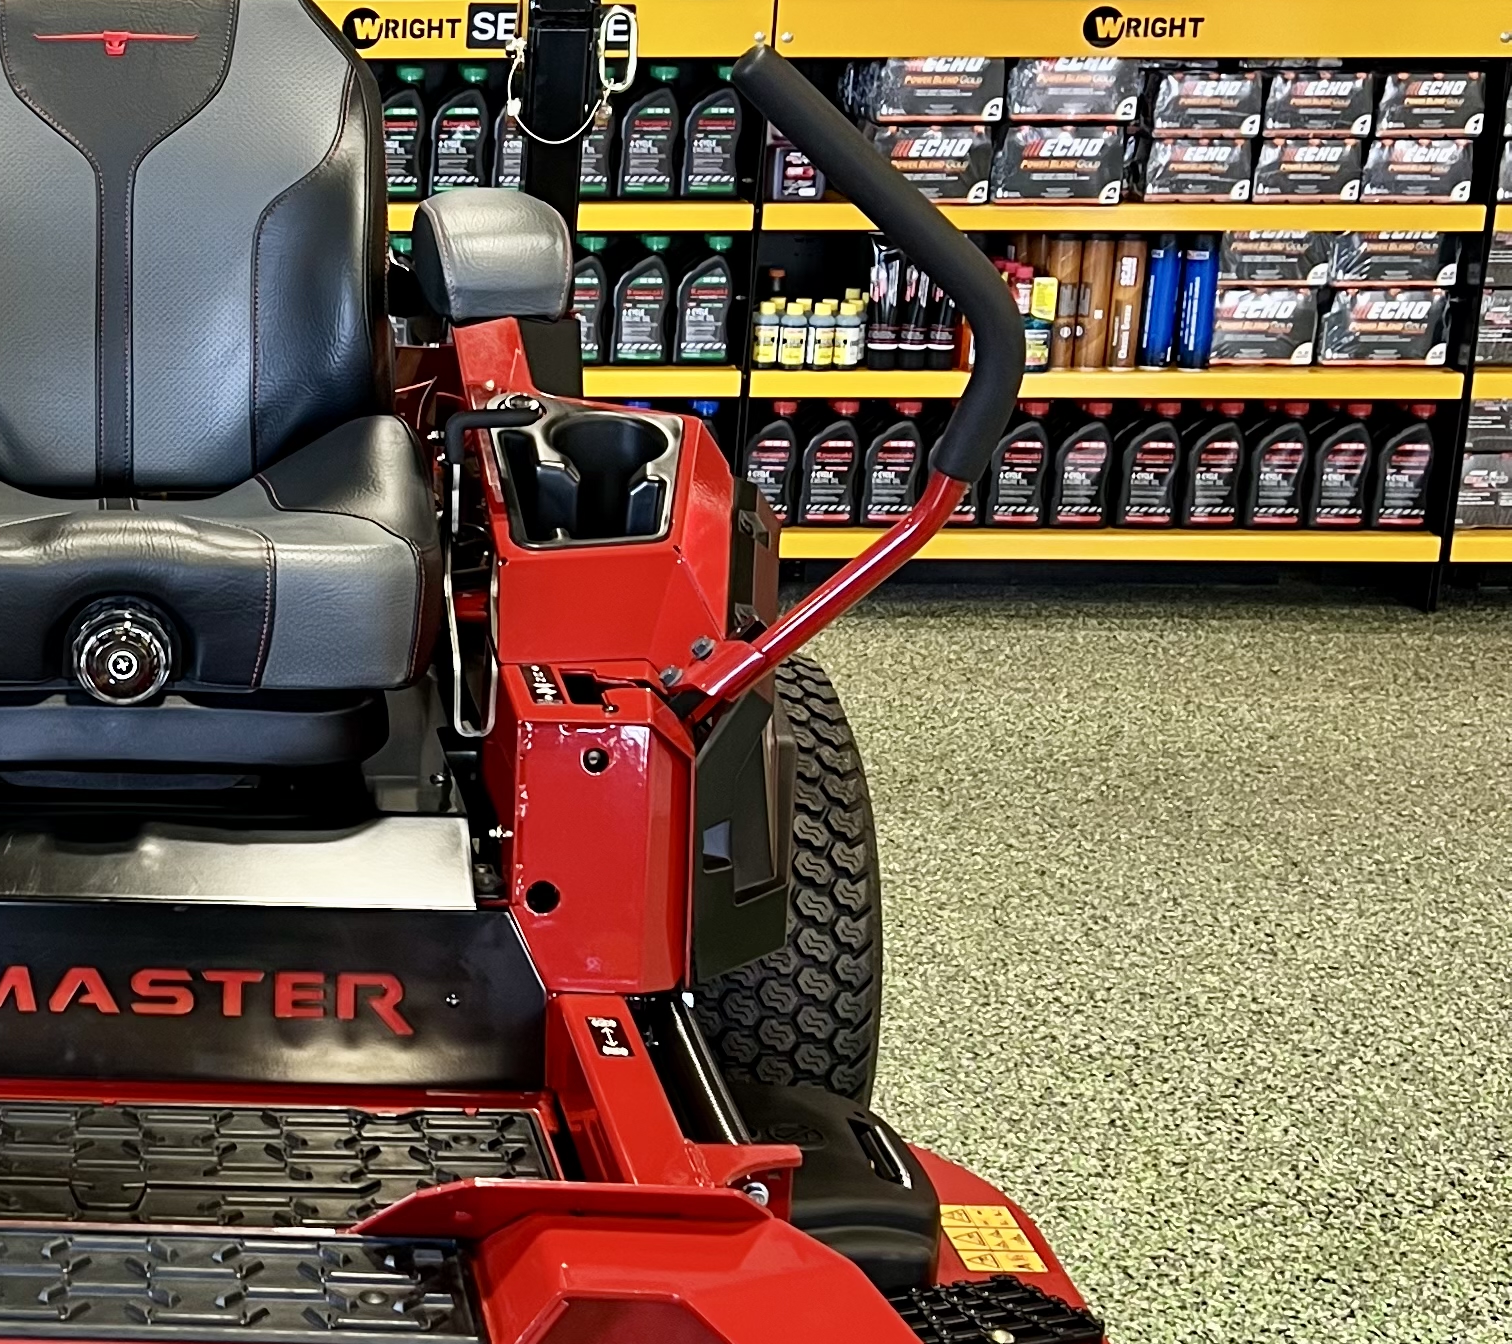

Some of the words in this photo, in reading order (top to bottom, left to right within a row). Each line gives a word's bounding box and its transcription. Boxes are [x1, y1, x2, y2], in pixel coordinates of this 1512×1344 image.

[343, 10, 462, 45] WRIGHT
[1083, 9, 1205, 45] WRIGHT
[921, 57, 986, 73] ECHO
[1193, 81, 1243, 96] ECHO
[1304, 81, 1353, 96] ECHO
[1418, 81, 1467, 96] ECHO
[988, 103, 1000, 117] 2
[1121, 102, 1133, 116] 2
[908, 138, 973, 157] ECHO
[1039, 138, 1105, 157] ECHO
[1182, 146, 1231, 162] ECHO
[1294, 146, 1343, 162] ECHO
[974, 186, 986, 200] 2
[1106, 185, 1118, 200] 2
[1234, 301, 1298, 319] ECHO
[1366, 301, 1431, 319] ECHO
